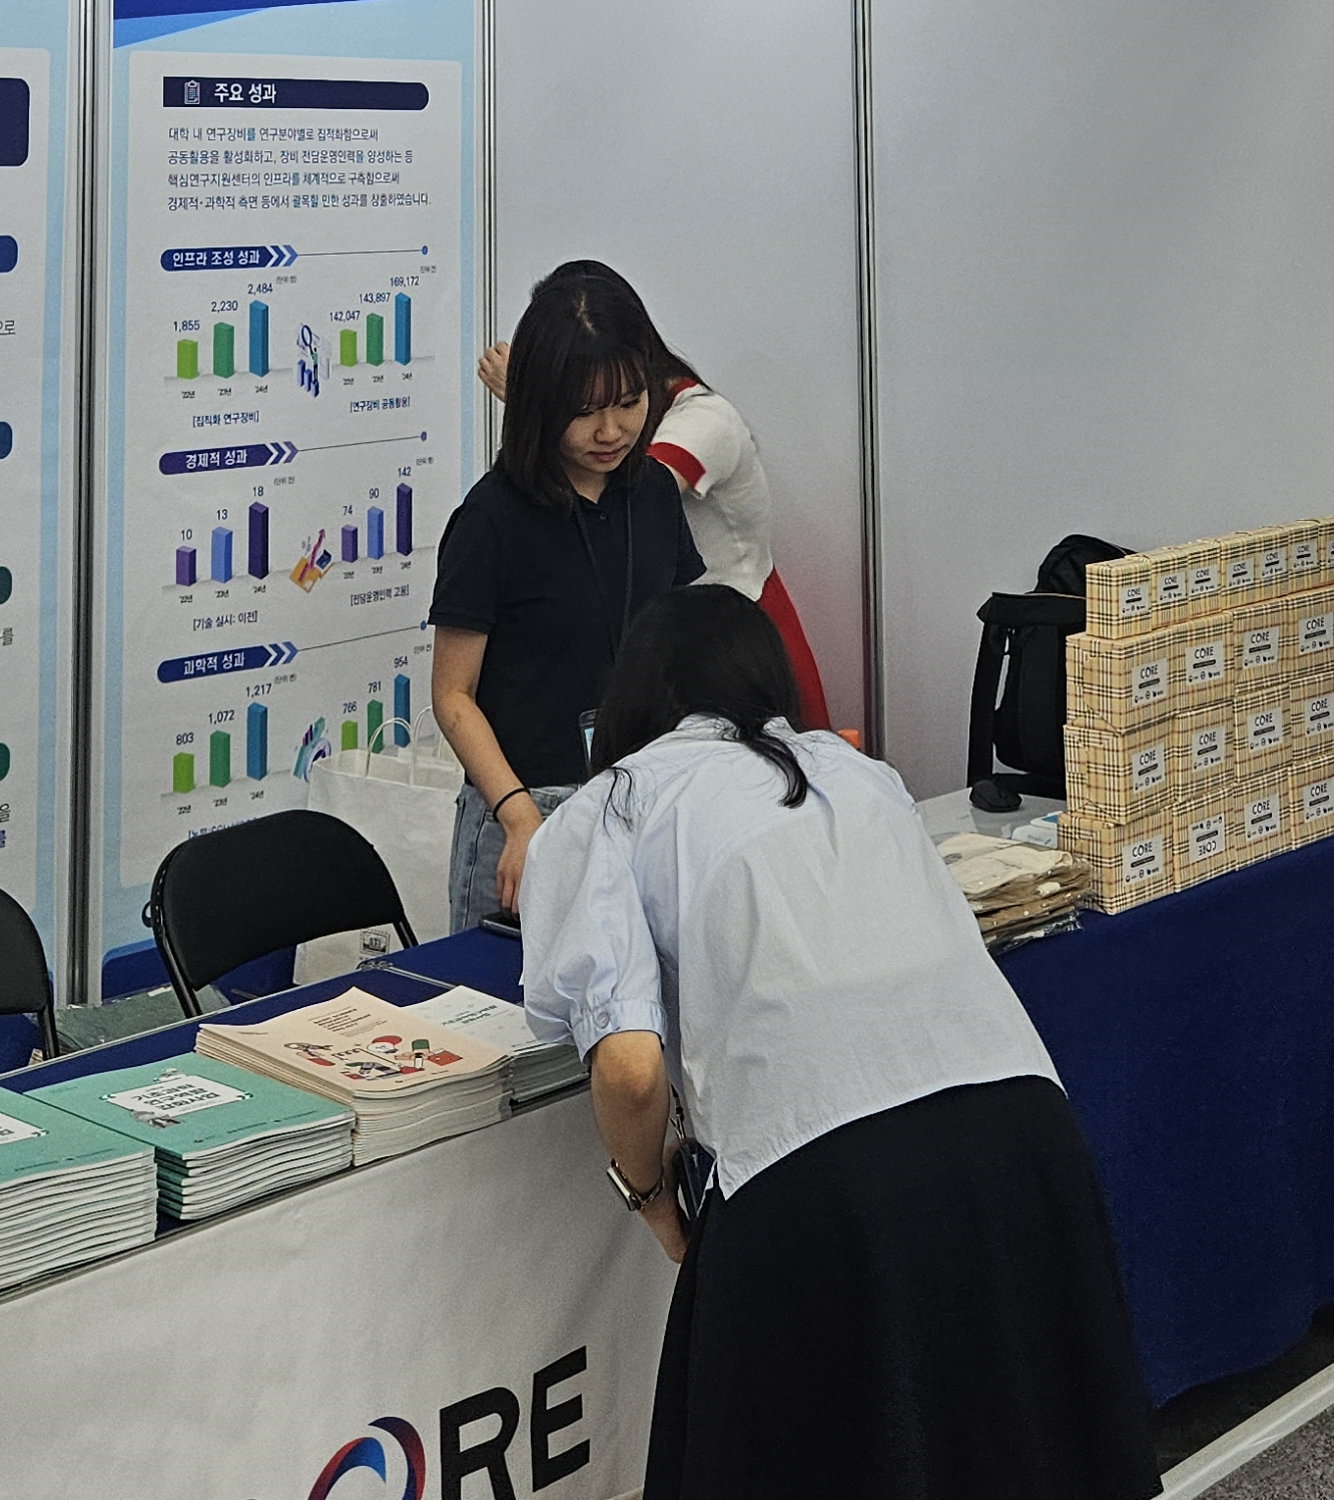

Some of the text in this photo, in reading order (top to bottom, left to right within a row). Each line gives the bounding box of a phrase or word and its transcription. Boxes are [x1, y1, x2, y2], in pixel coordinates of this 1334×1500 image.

[214, 84, 276, 103] 주요 성과
[169, 128, 189, 141] 대학
[173, 250, 259, 267] 인프라 조성 성과
[248, 283, 273, 295] 2,484
[211, 301, 238, 313] 2,230
[174, 320, 200, 332] 1,855
[186, 449, 248, 469] 경제적 성과
[217, 509, 227, 520] 13
[184, 652, 244, 674] 과학적 성과
[209, 710, 234, 724] 1,072
